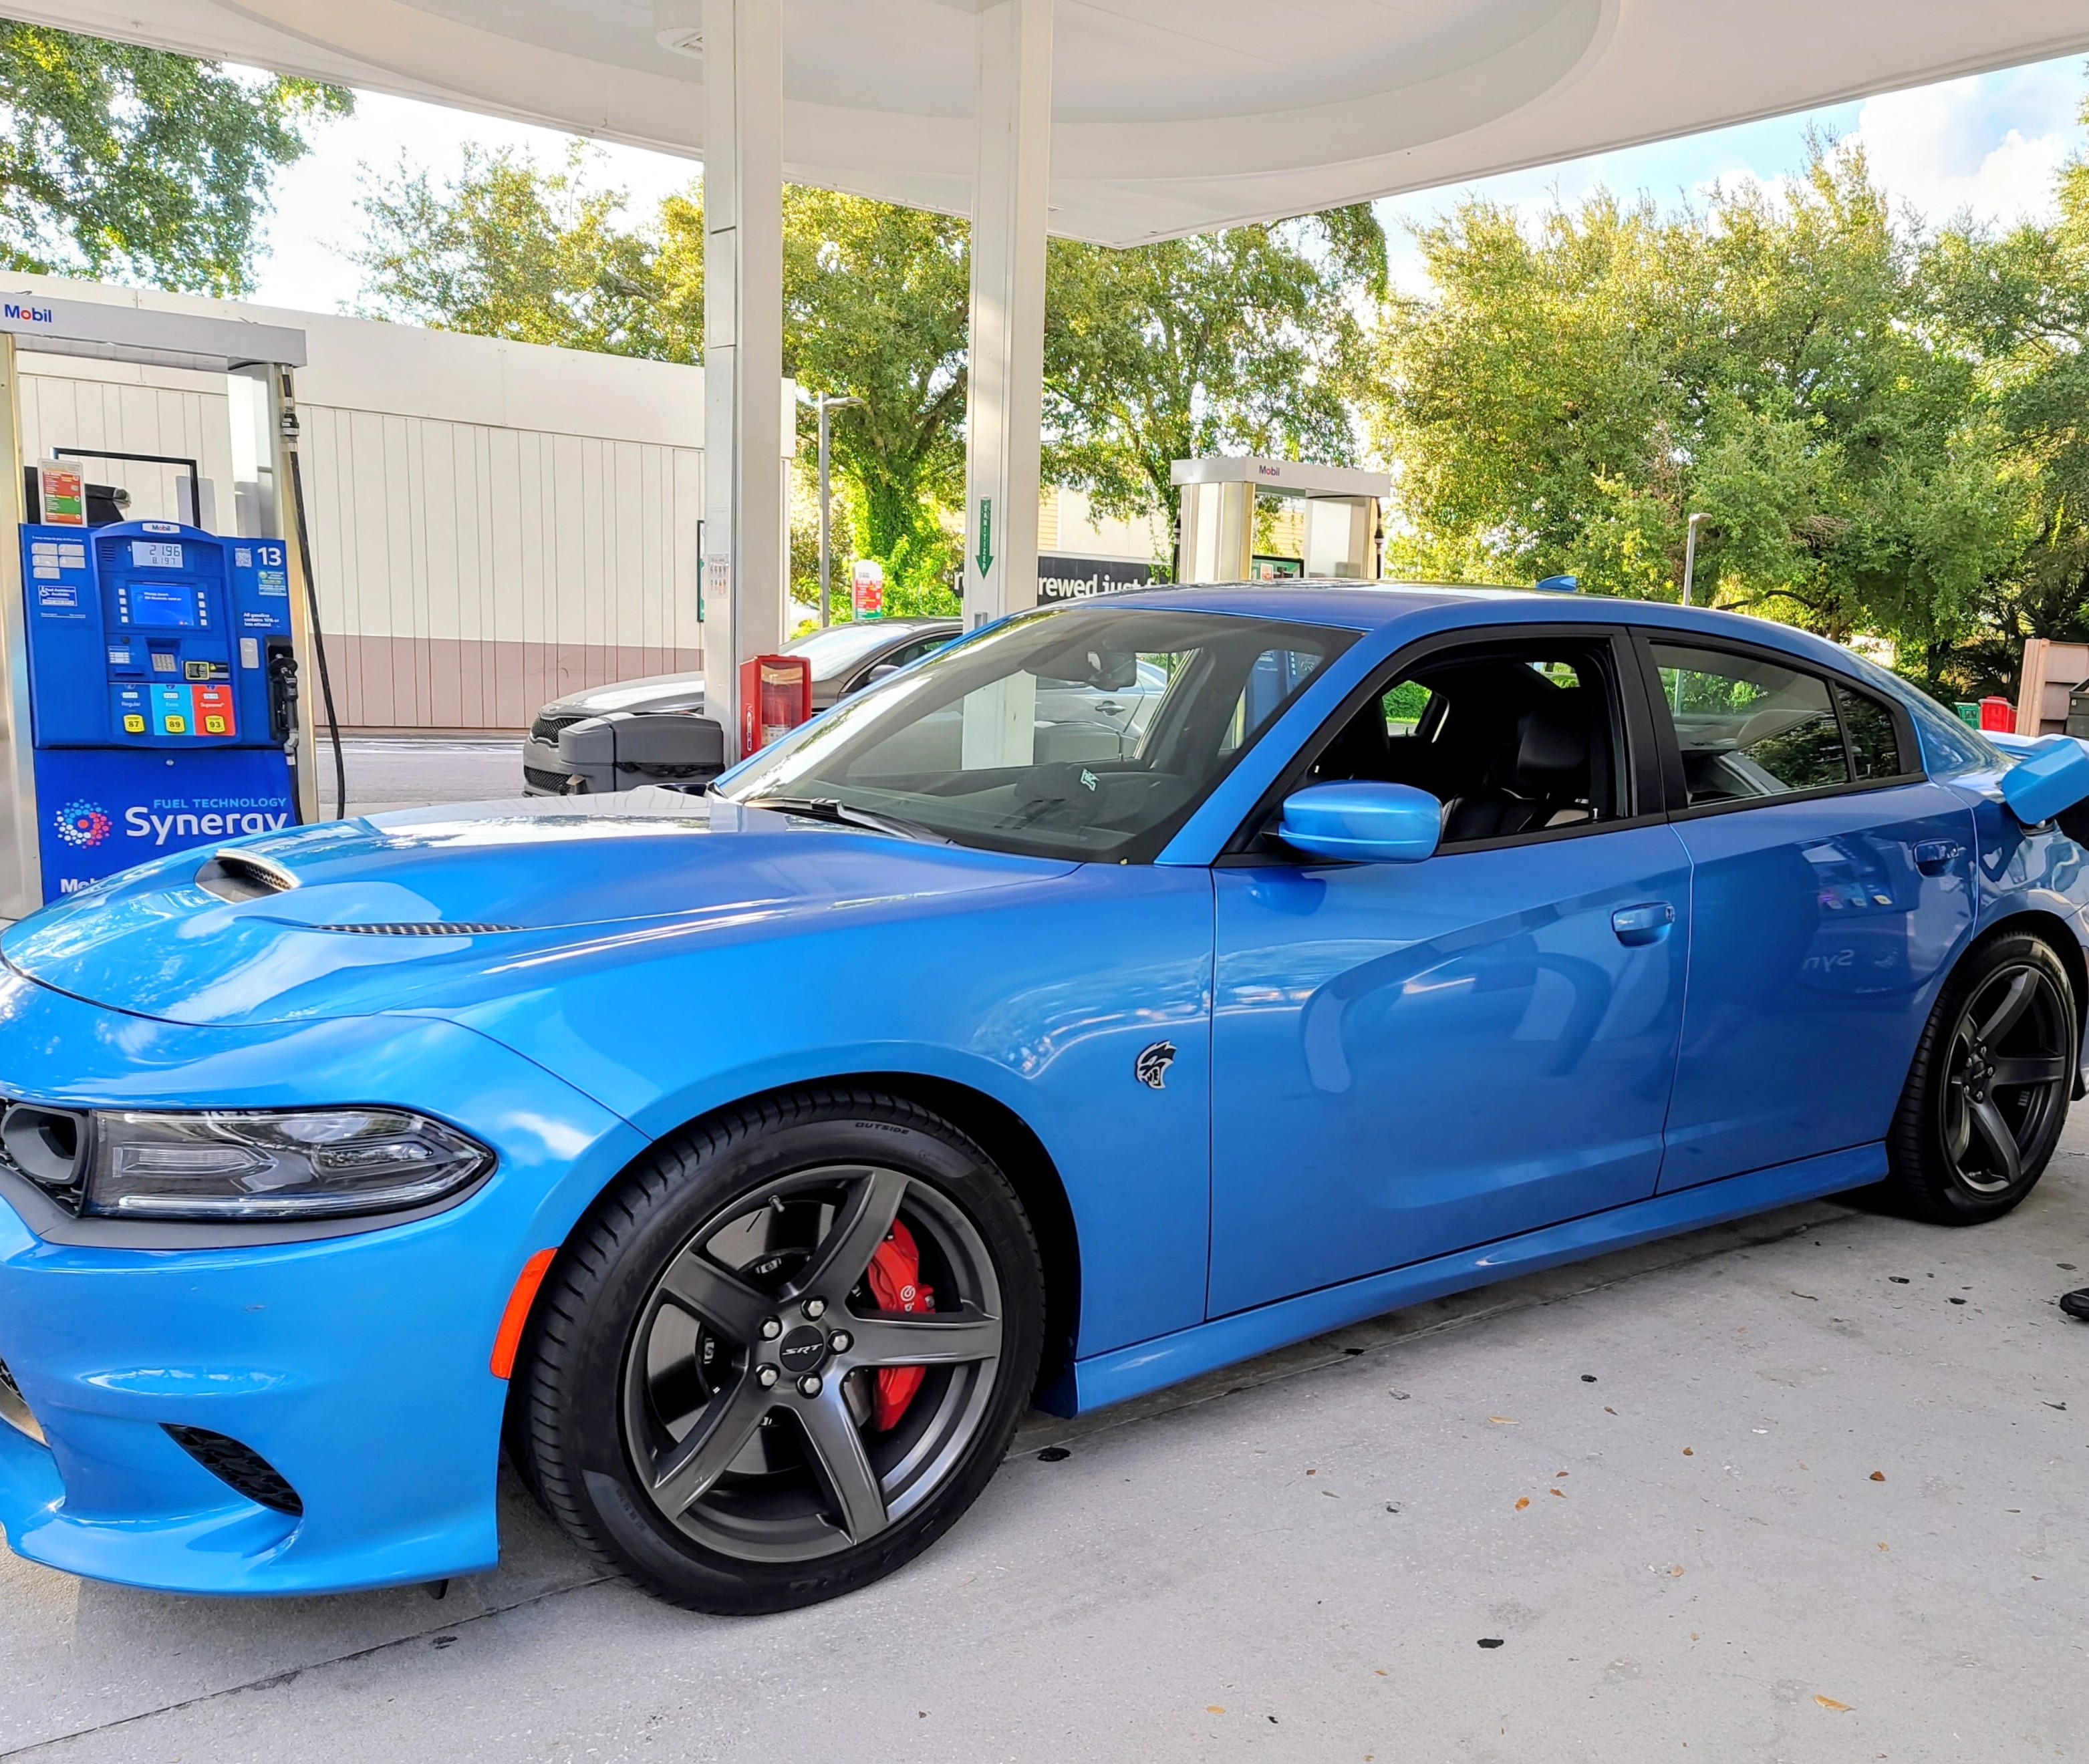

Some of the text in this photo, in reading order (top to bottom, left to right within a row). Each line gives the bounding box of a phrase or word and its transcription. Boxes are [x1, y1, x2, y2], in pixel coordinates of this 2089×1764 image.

[4, 303, 52, 323] Mobil
[1259, 465, 1280, 476] Mobil
[257, 547, 282, 566] 13
[154, 798, 287, 809] FUEL TECHNOLOGY
[855, 1122, 910, 1135] OUTSIDE
[782, 1343, 823, 1356] SRT
